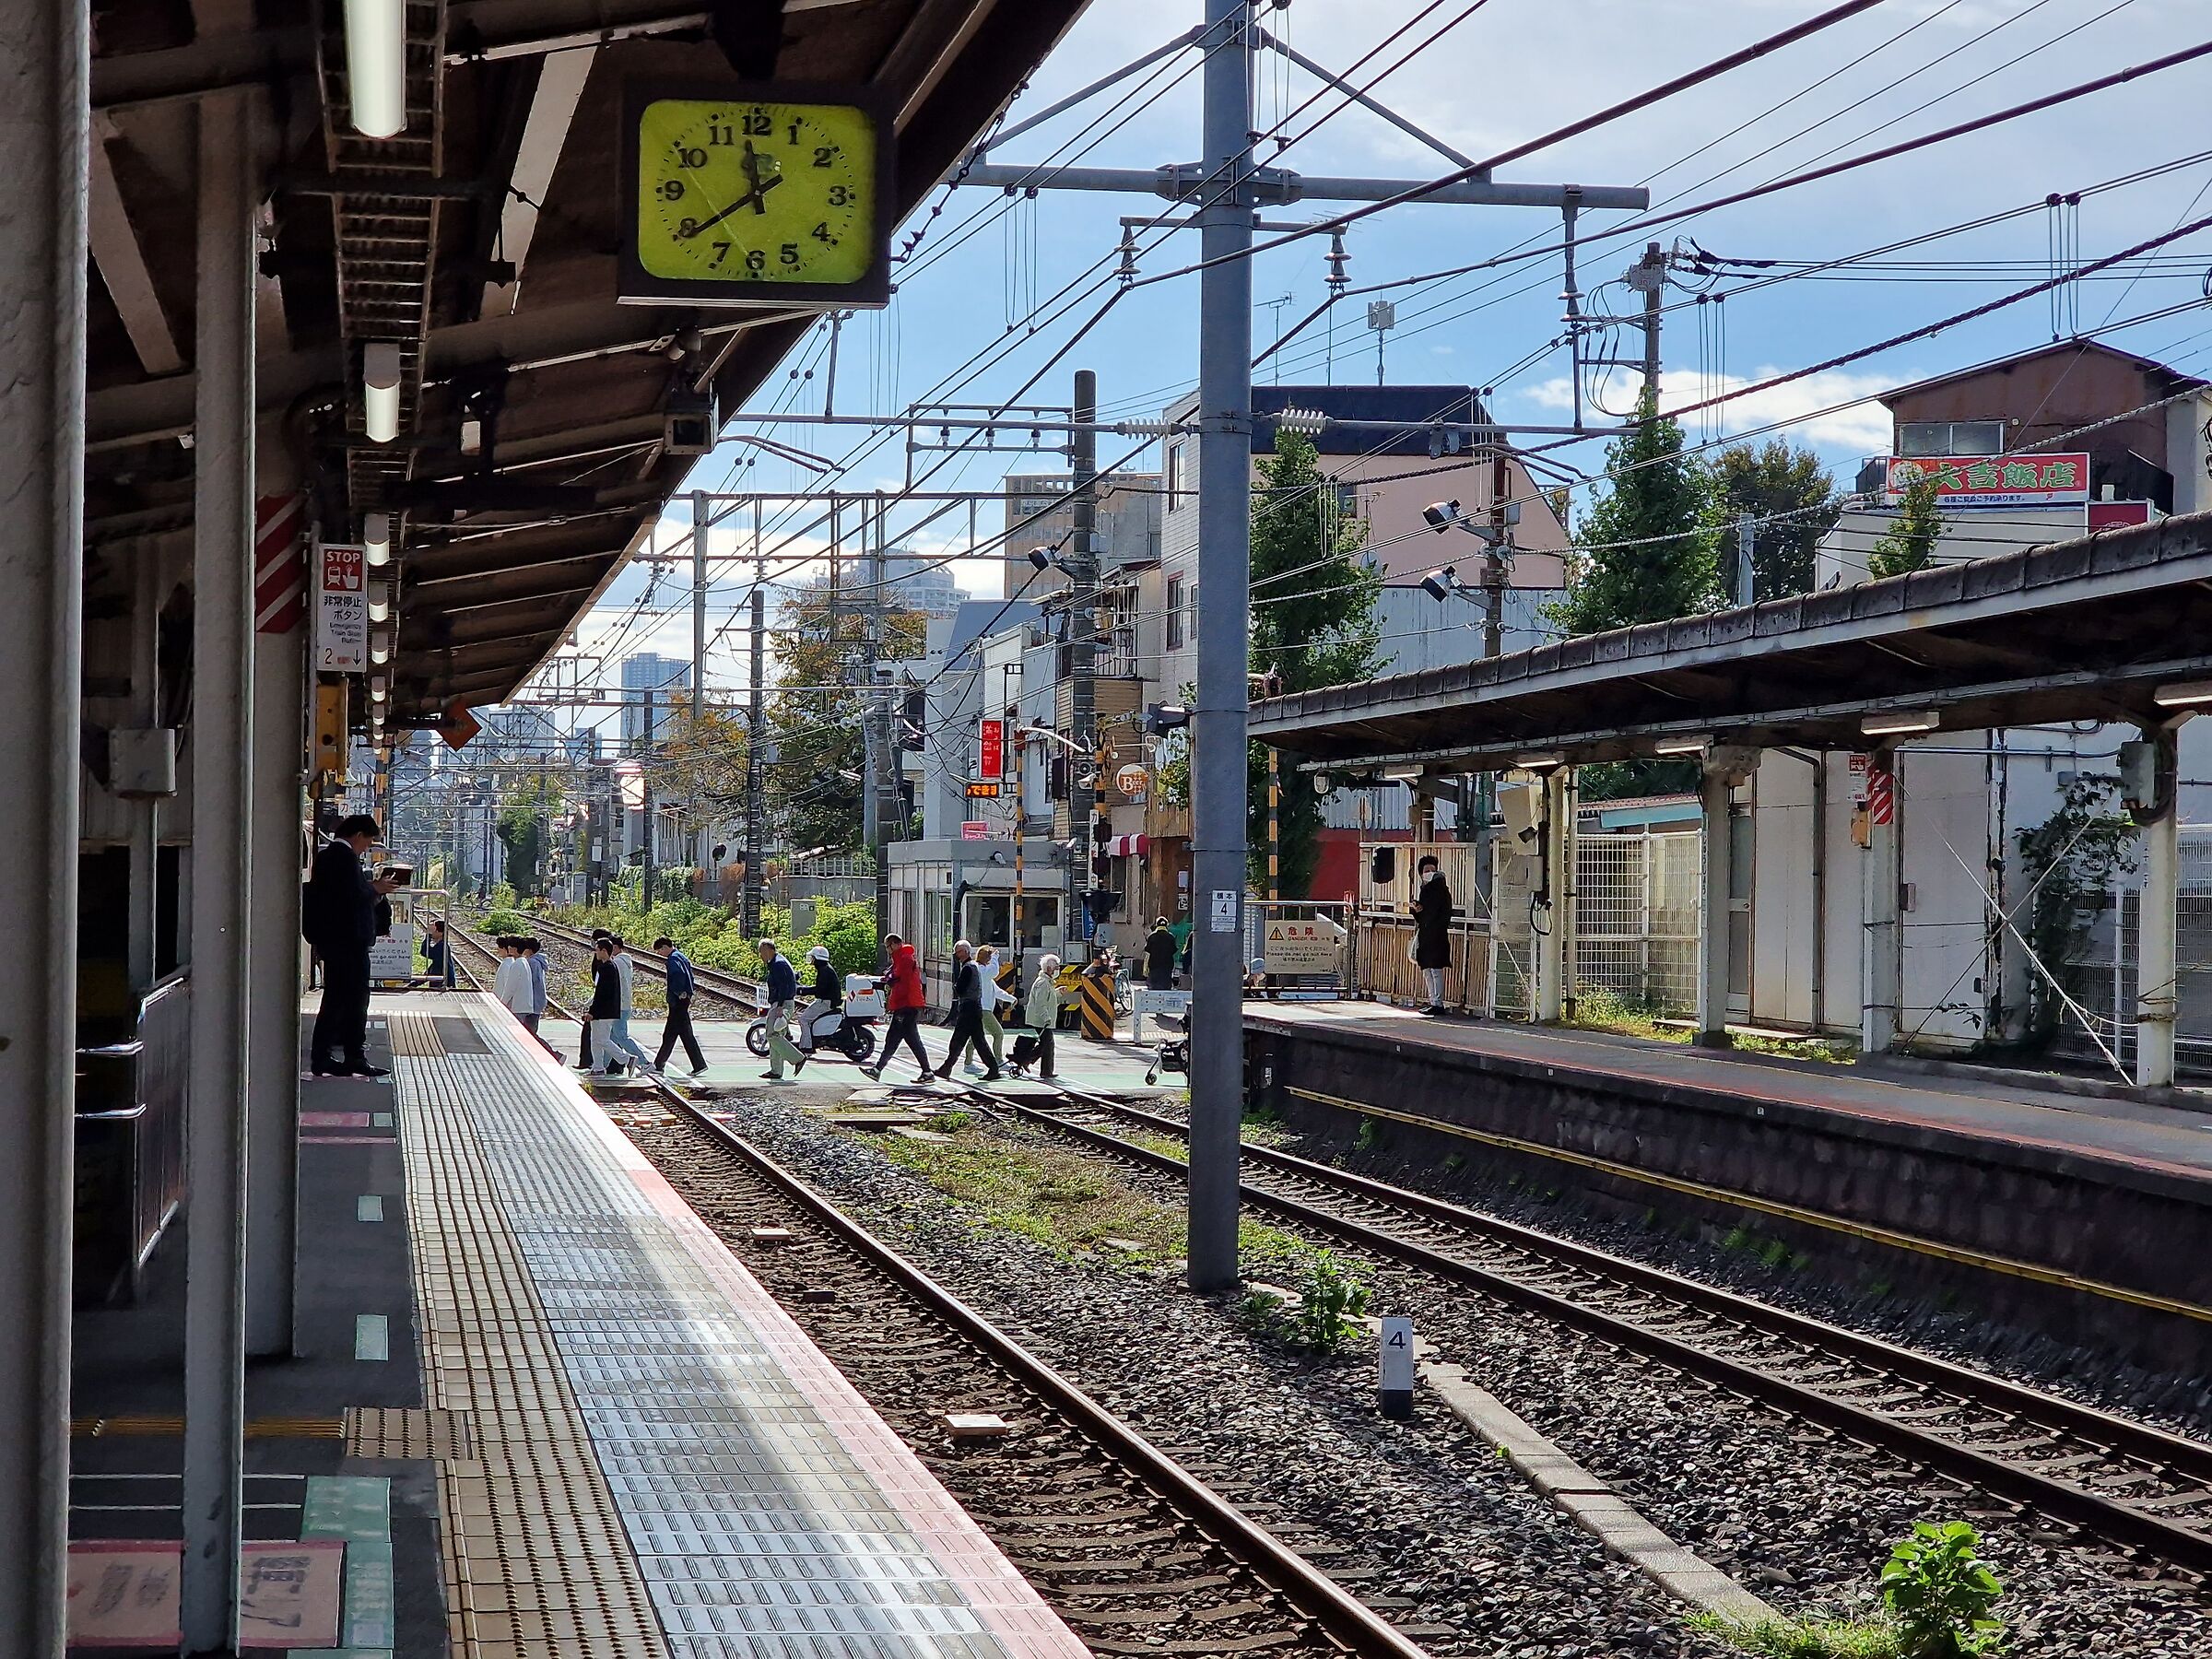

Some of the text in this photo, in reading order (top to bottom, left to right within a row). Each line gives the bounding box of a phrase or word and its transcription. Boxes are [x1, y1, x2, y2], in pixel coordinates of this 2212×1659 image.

[742, 115, 771, 135] 12
[788, 125, 799, 145] 1
[709, 125, 735, 146] 11
[677, 148, 708, 169] 10
[813, 147, 832, 168] 2
[665, 180, 685, 201] 9
[830, 185, 847, 206] 3
[677, 218, 699, 239] 8
[812, 222, 830, 241] 4
[712, 241, 731, 263] 7
[746, 250, 766, 270] 6
[781, 243, 799, 264] 5
[326, 551, 361, 563] STOP
[324, 595, 362, 607] 非常停止
[334, 609, 363, 620] ボタン
[324, 648, 333, 665] 2
[1220, 902, 1228, 915] 4
[1388, 1331, 1406, 1349] 4
